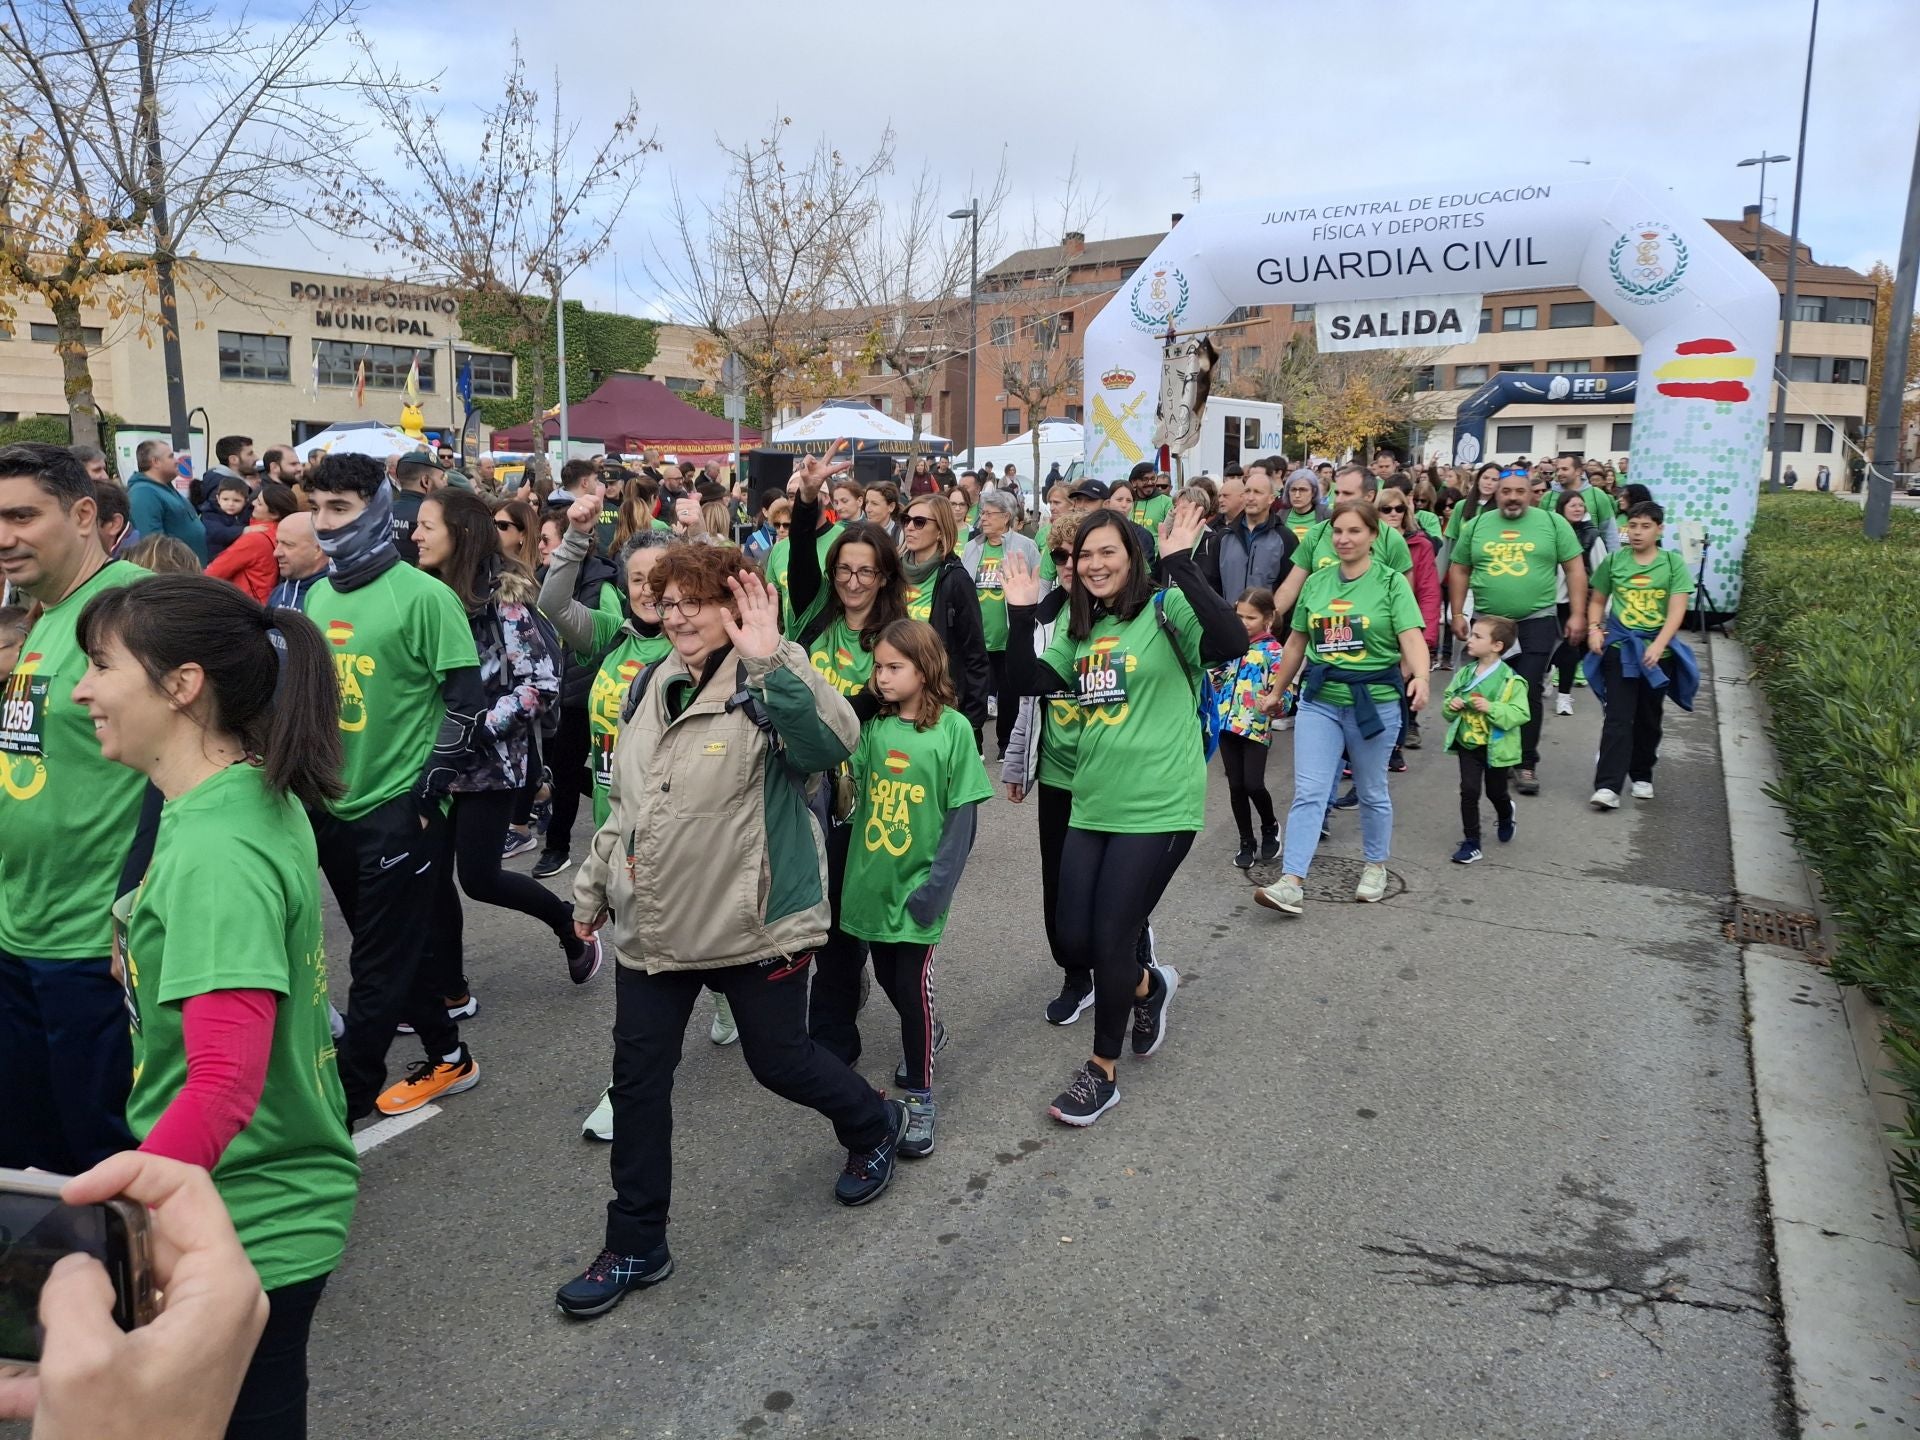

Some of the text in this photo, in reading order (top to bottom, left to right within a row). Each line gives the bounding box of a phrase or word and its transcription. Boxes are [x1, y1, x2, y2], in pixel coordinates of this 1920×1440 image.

[1261, 185, 1551, 225] JUNTA CENTRAL DE EDUCACIÓN
[1312, 212, 1485, 241] FÍSICA Y DEPORTES
[1256, 236, 1549, 285] GUARDIA CIVIL
[290, 281, 456, 314] POLIDEPORTIVO
[316, 310, 434, 337] MUNICIPAL
[1130, 320, 1168, 335] GUARDIA
[1330, 308, 1463, 341] SALIDA
[1572, 378, 1608, 393] FFD
[1483, 541, 1535, 554] Corre
[1490, 550, 1526, 562] TEA
[1324, 626, 1353, 643] 240
[335, 653, 376, 678] rre
[1078, 669, 1117, 693] 1039
[2, 699, 35, 732] 1259
[869, 771, 925, 804] Corre
[871, 794, 910, 825] TEA
[887, 822, 913, 841] AUTISMO
